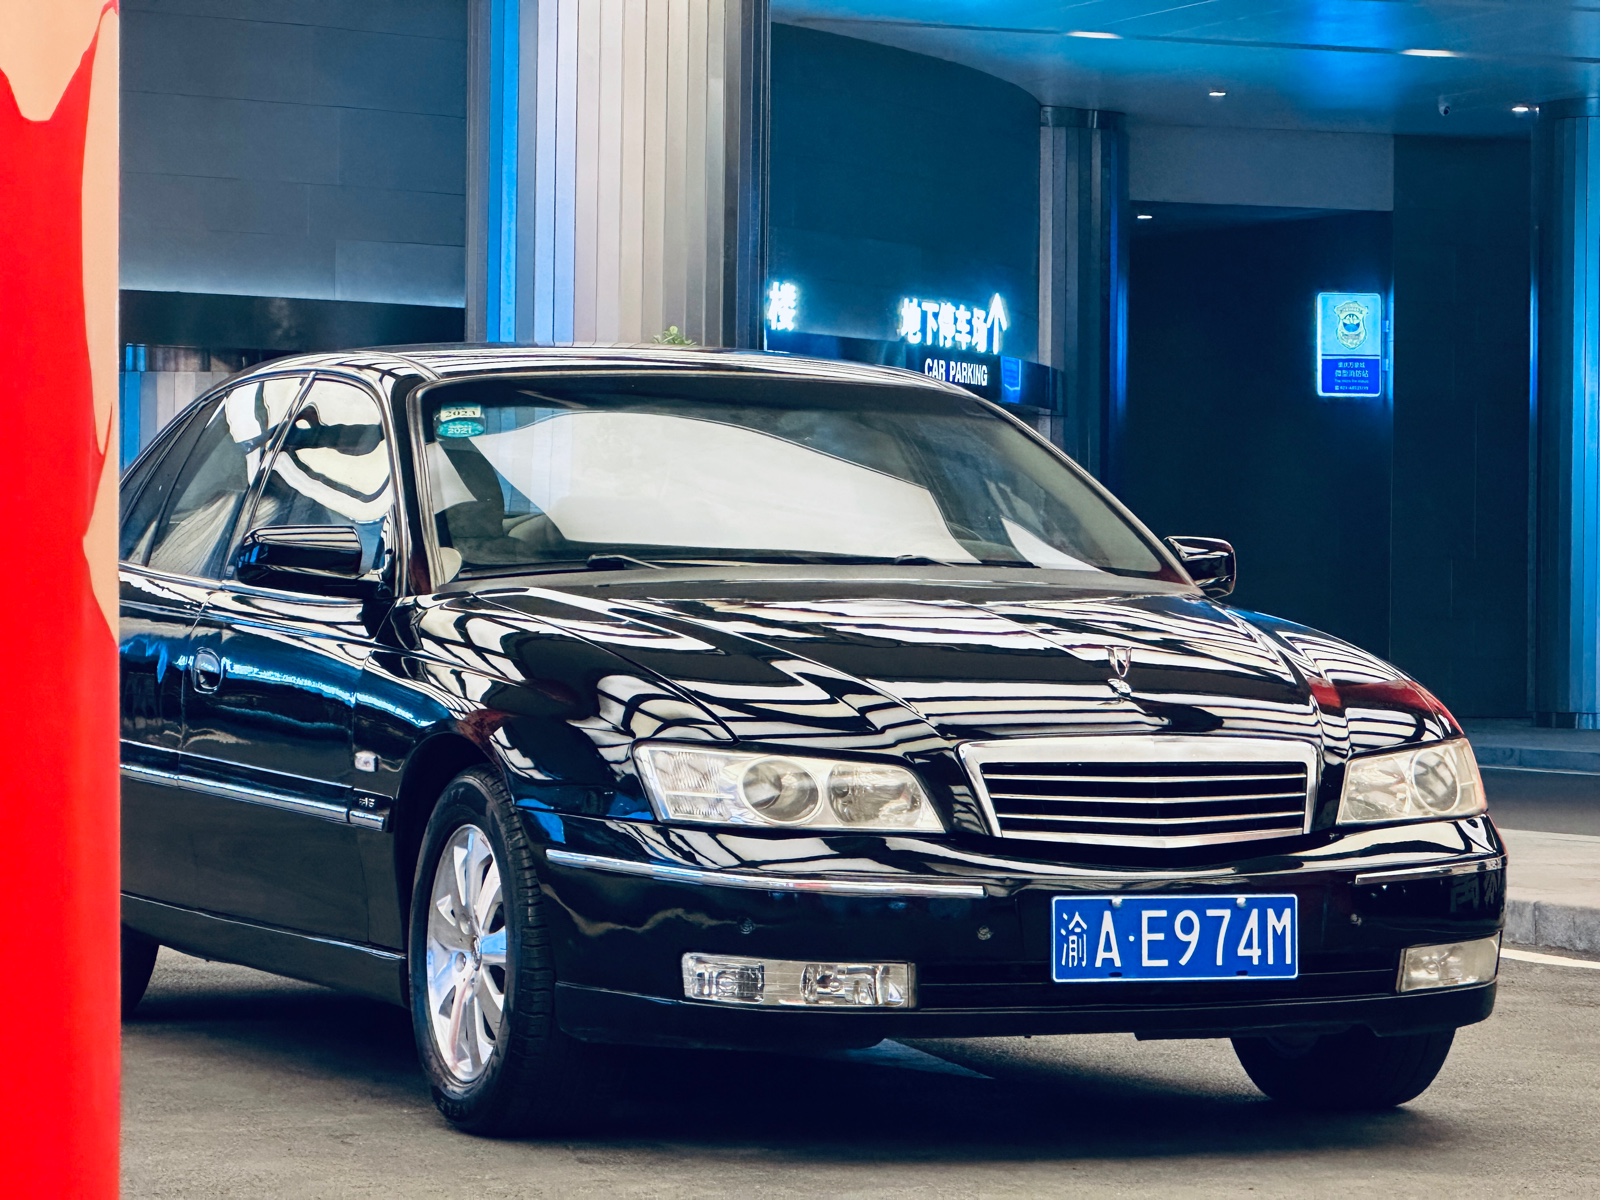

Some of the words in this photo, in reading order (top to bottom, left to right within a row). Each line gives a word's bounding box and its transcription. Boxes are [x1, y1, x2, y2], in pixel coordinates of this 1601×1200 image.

[901, 297, 988, 353] 地下停车场
[924, 357, 946, 382] CAR
[949, 361, 988, 387] PARKING
